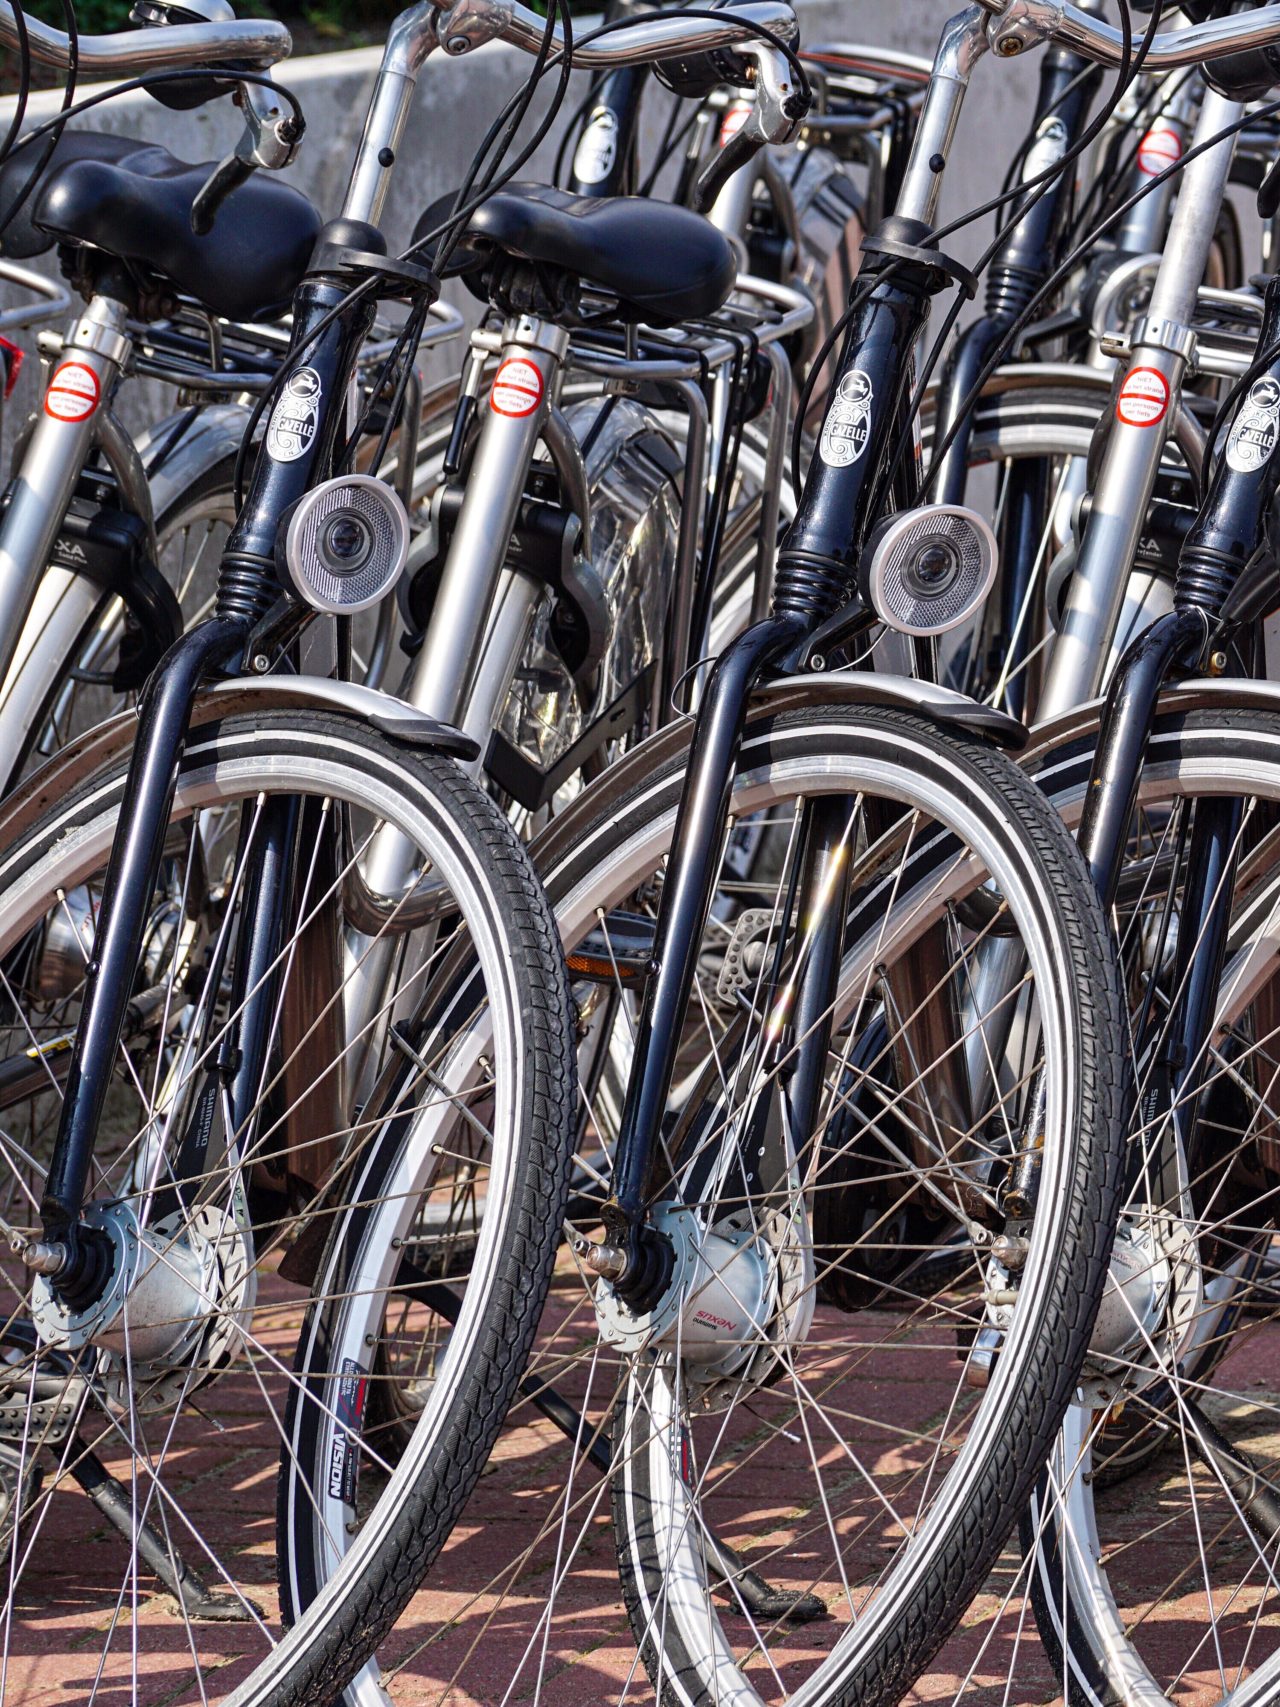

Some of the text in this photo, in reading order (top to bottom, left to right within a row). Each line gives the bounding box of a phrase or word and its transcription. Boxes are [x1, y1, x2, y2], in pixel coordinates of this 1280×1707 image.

[279, 417, 315, 437] GAZELLE
[832, 422, 867, 442] GAZELLE
[1239, 427, 1275, 447] GAZELLE
[201, 1087, 216, 1147] SHIMANO
[331, 1433, 346, 1498] VISION
